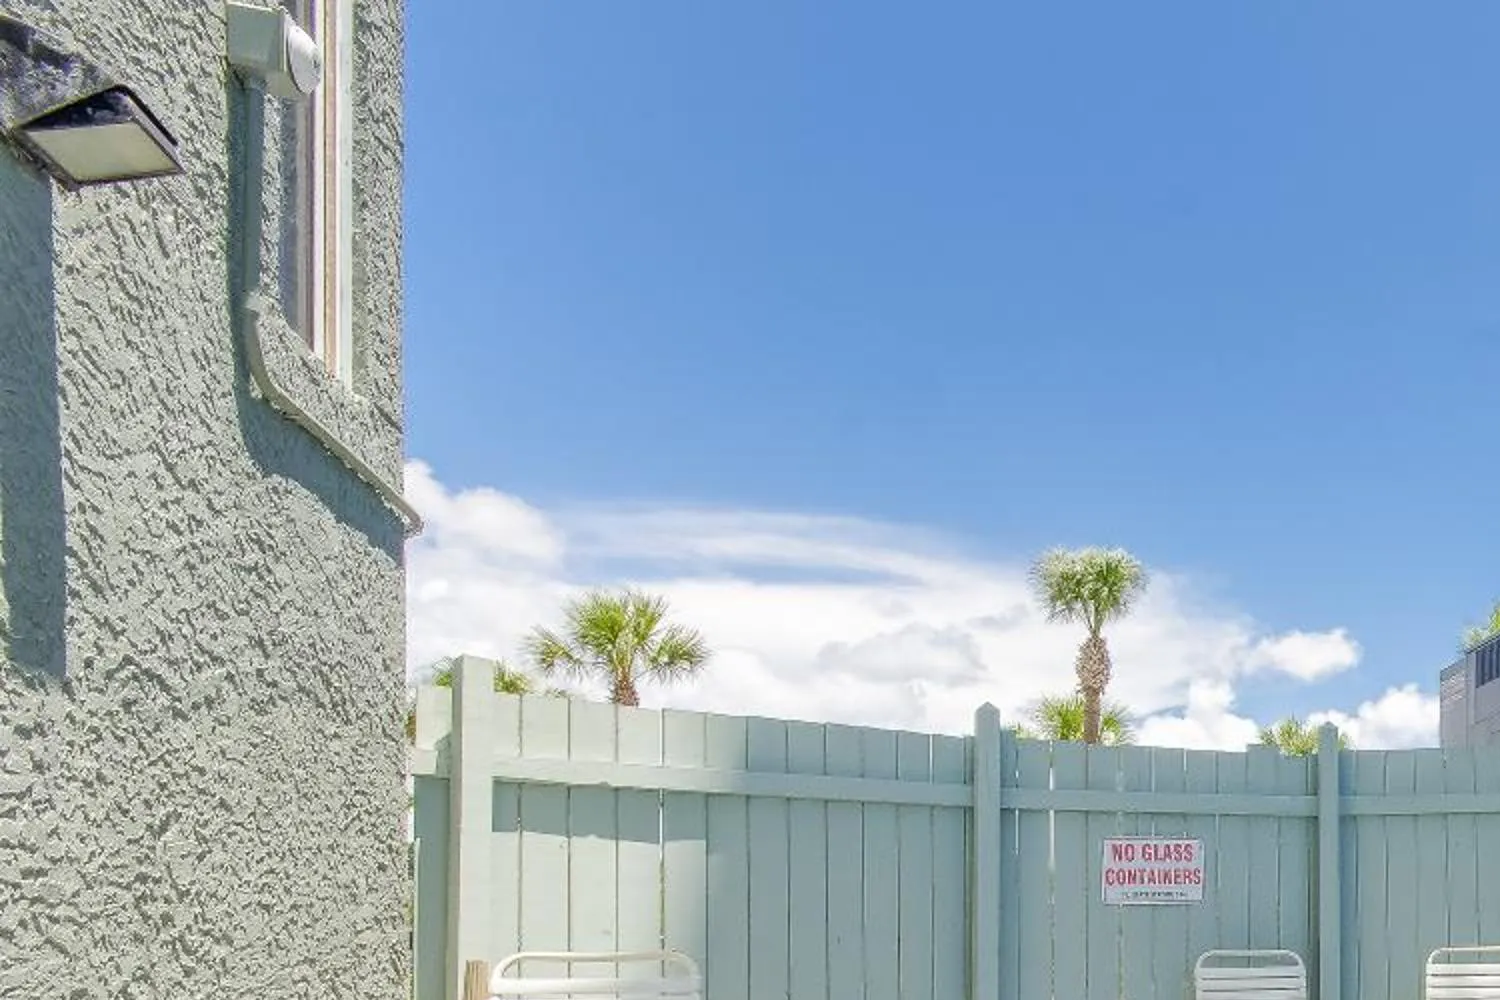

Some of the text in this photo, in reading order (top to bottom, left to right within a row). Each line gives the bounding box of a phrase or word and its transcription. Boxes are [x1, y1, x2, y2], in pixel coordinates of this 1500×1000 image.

[1112, 843, 1193, 863] NO GLASS
[1105, 868, 1202, 886] CONTAINERS
